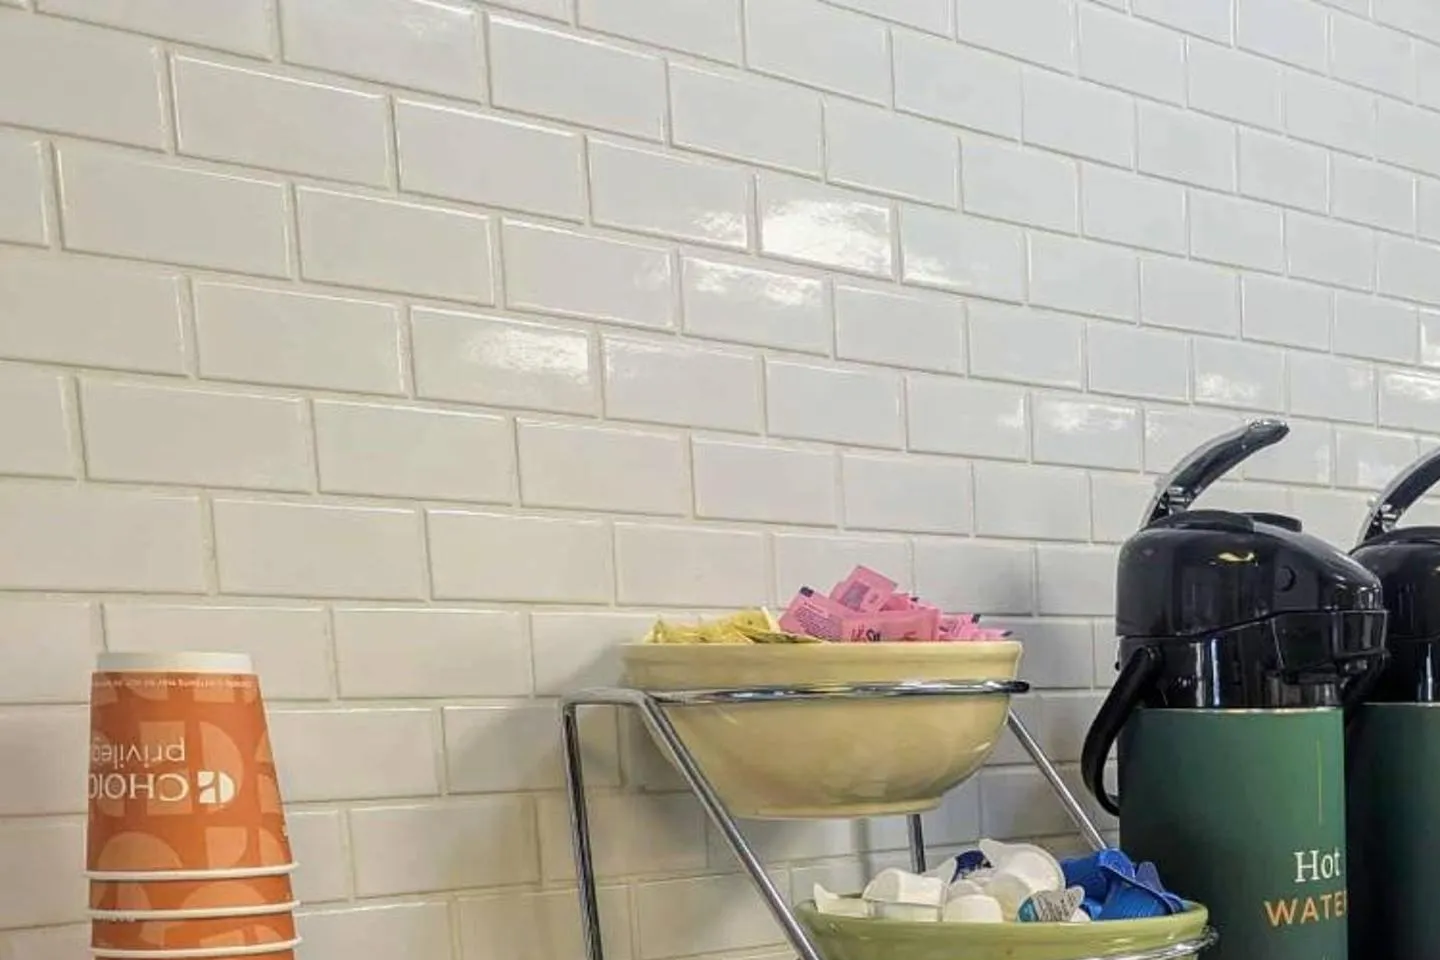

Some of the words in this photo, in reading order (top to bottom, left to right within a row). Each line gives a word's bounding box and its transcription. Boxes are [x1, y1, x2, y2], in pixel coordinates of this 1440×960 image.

[92, 736, 186, 769] privileg
[89, 773, 190, 802] CHOIC
[1293, 847, 1341, 883] Hot
[1263, 890, 1346, 927] WATE
